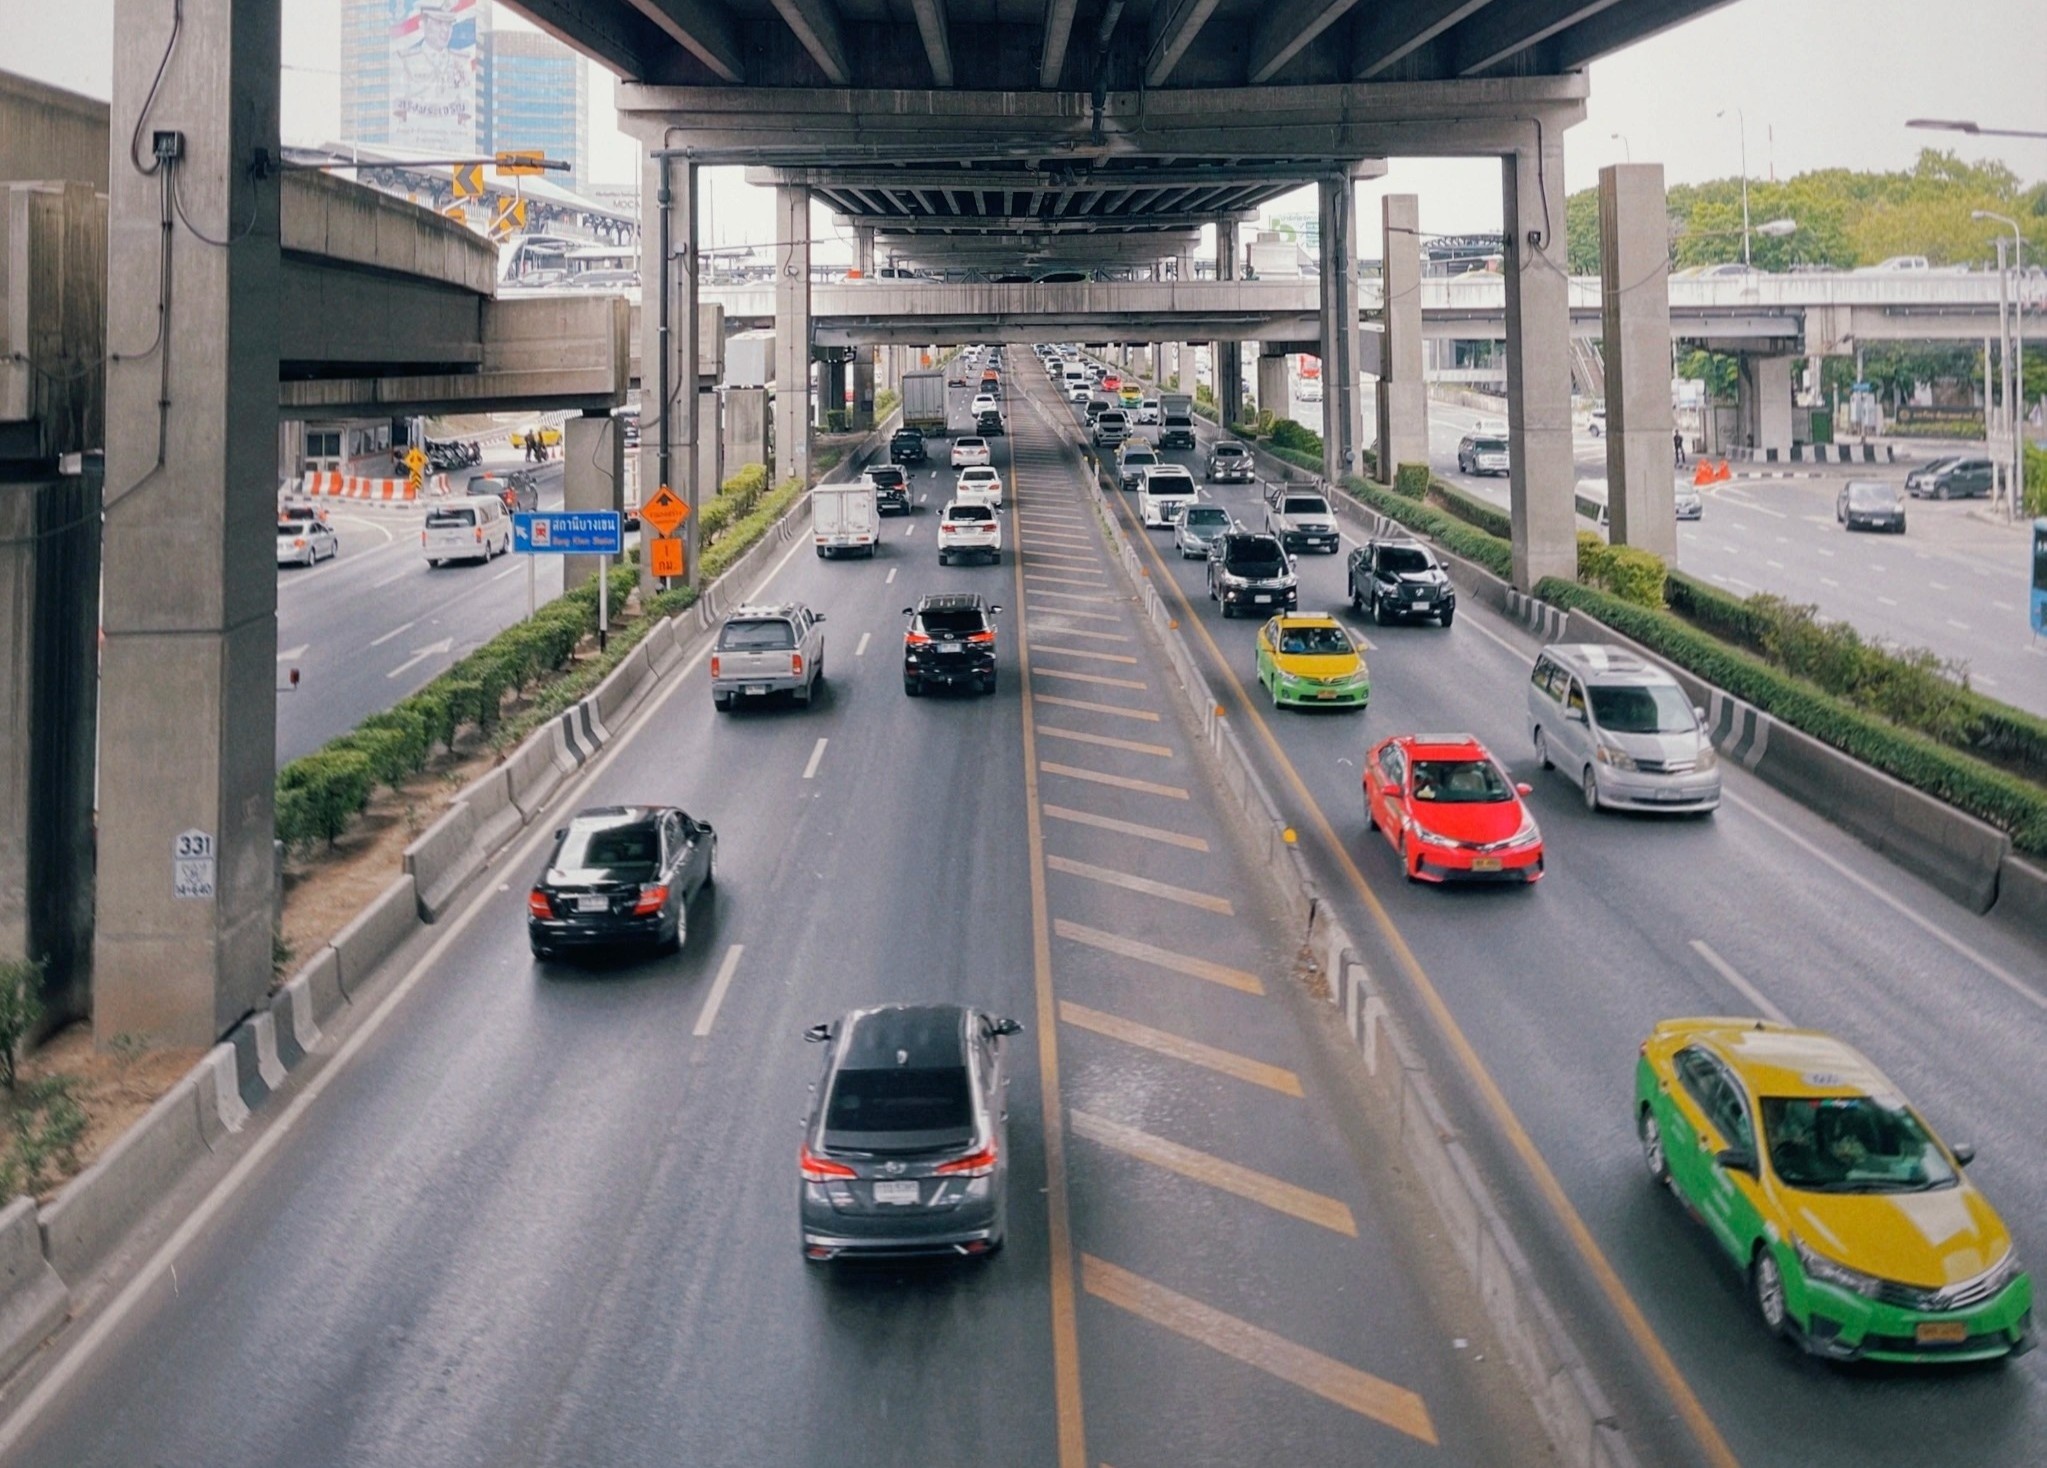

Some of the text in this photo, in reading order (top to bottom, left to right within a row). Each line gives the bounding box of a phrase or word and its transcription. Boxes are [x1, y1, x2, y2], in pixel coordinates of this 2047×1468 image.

[552, 516, 615, 531] สถานีบางเขน
[179, 836, 210, 855] 331
